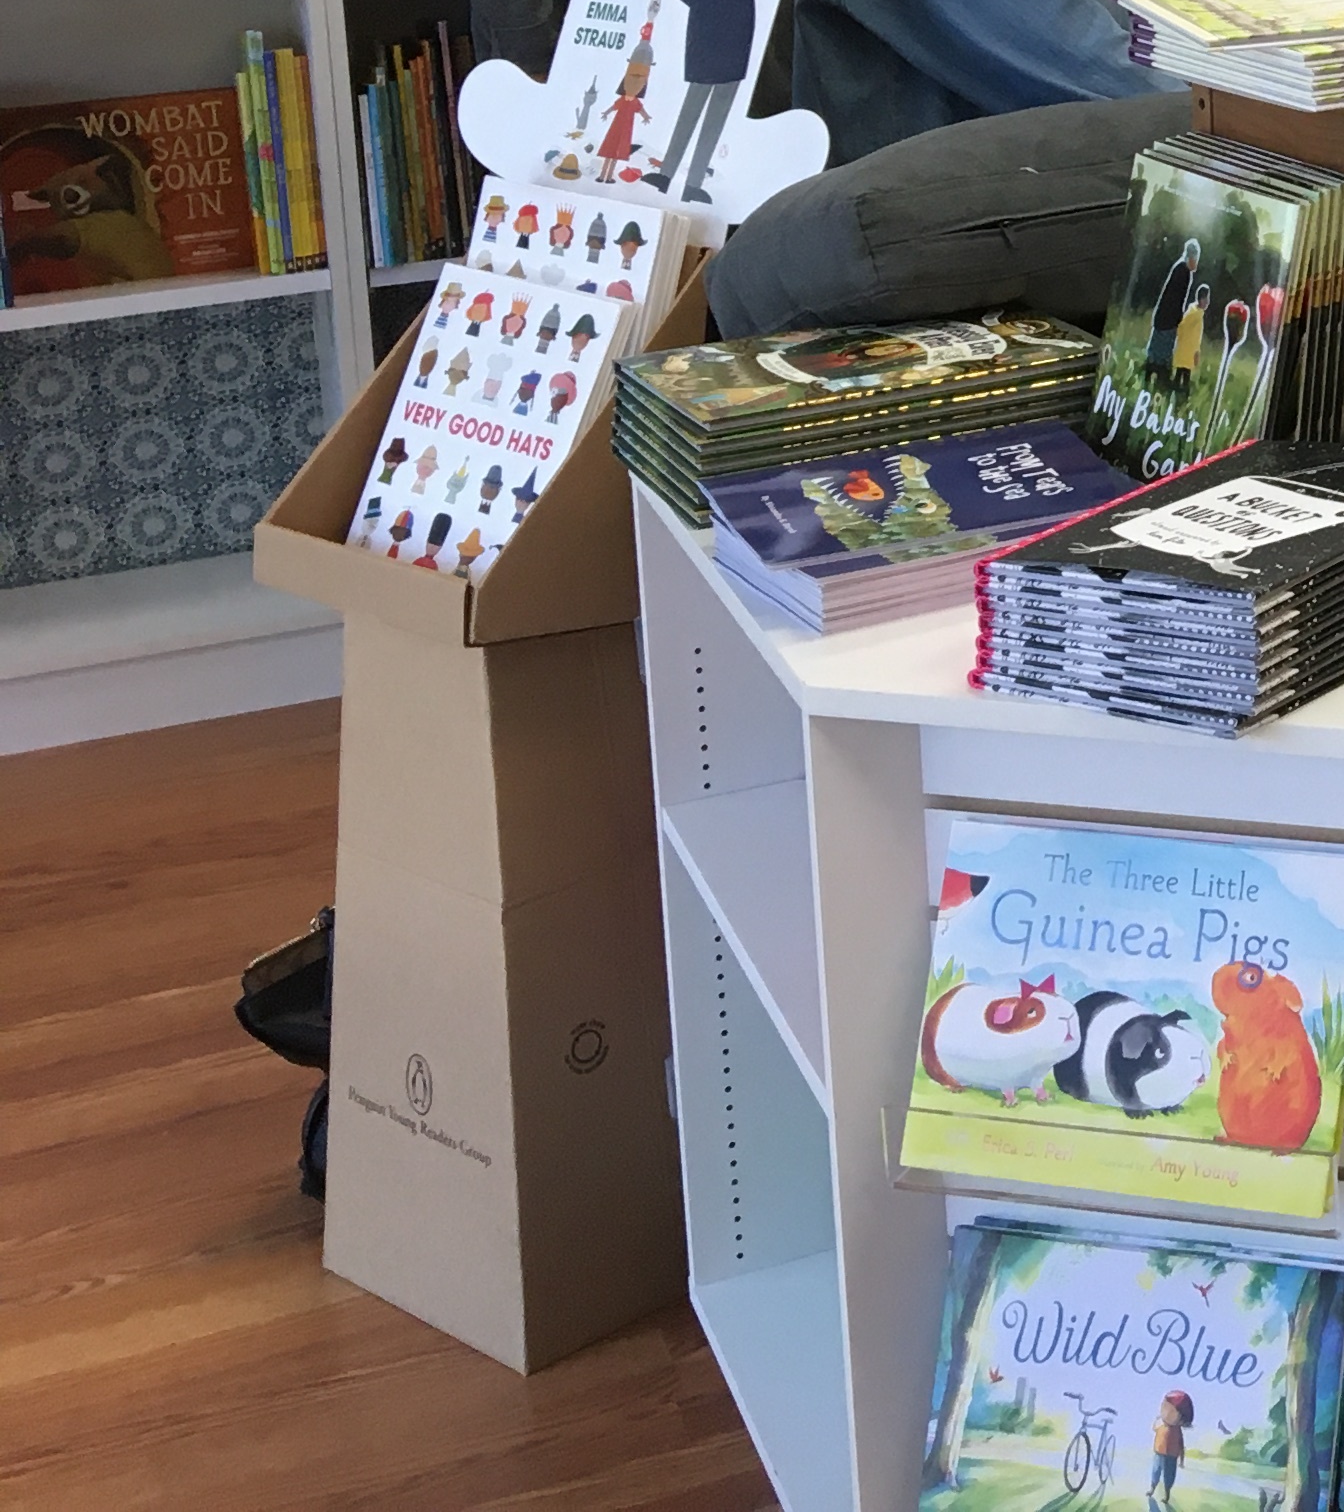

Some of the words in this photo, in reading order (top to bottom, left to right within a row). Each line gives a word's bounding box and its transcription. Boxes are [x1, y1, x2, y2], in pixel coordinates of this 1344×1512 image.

[585, 0, 629, 24] EMMA
[573, 27, 627, 51] STRAUB
[75, 100, 224, 140] WOMBAT
[150, 130, 230, 163] SAID
[143, 157, 234, 195] COME
[185, 189, 225, 221] IN
[1093, 375, 1126, 446] My
[1129, 386, 1201, 443] Baba's
[402, 399, 448, 432] VERY
[448, 413, 504, 448] GOOD
[506, 429, 554, 462] HATS
[1021, 467, 1075, 497] Tears
[1171, 504, 1284, 542] QUESTIONS
[1216, 492, 1240, 503] A
[1234, 496, 1323, 523] BUCKET
[1042, 853, 1093, 888] The
[1106, 858, 1180, 896] Three
[1190, 868, 1260, 903] Little
[989, 888, 1173, 967] Guinea
[1192, 907, 1291, 987] Pigs
[459, 1139, 493, 1169] Group
[1042, 1140, 1077, 1163] Perl
[1149, 1154, 1186, 1182] Amy
[1190, 1159, 1241, 1188] Young
[1001, 1299, 1133, 1369] Wild
[1130, 1307, 1265, 1388] Blue
